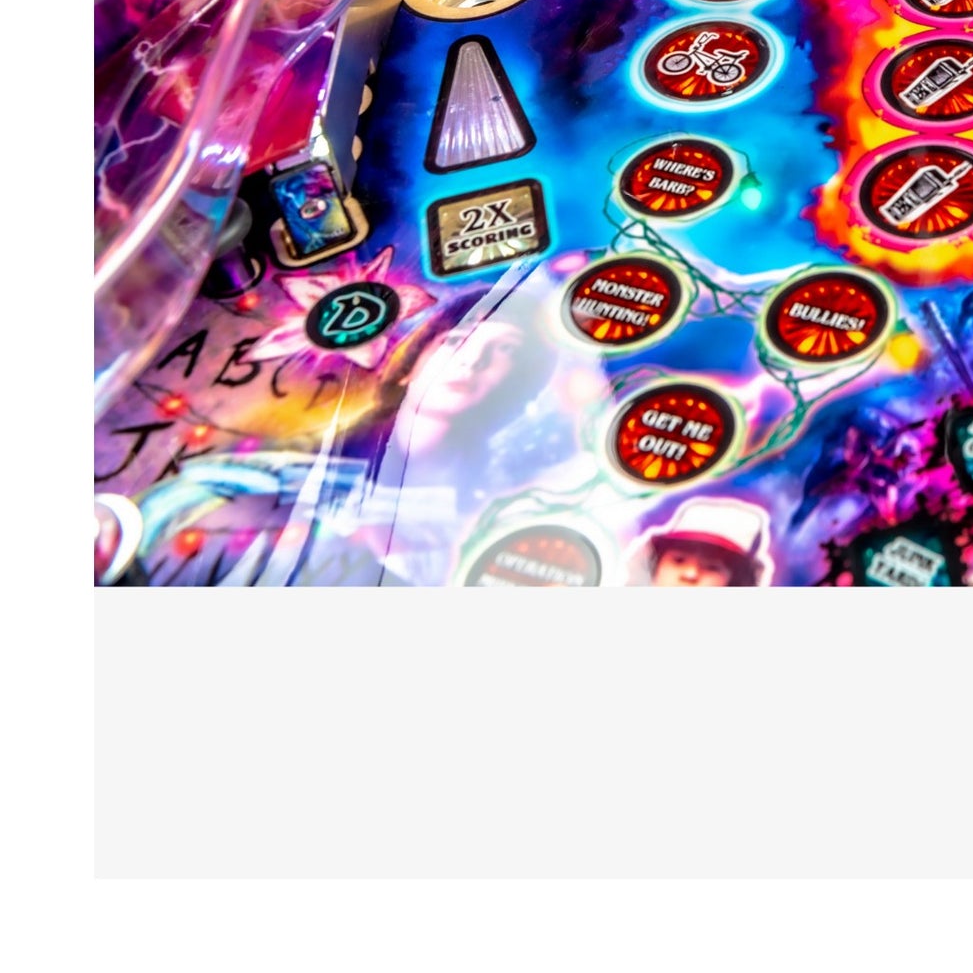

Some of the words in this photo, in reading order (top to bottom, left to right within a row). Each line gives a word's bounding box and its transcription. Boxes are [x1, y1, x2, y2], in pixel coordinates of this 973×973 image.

[653, 158, 715, 182] WHERE'S
[648, 176, 696, 196] BARB?
[461, 200, 514, 234] 2X
[446, 223, 532, 255] SCORING
[591, 278, 664, 307] MONSTER
[322, 291, 387, 335] D
[576, 297, 650, 327] HUNTING!
[789, 302, 866, 332] BULLIES!
[641, 409, 682, 432] GET
[682, 417, 714, 442] ME
[638, 434, 688, 460] OUT!
